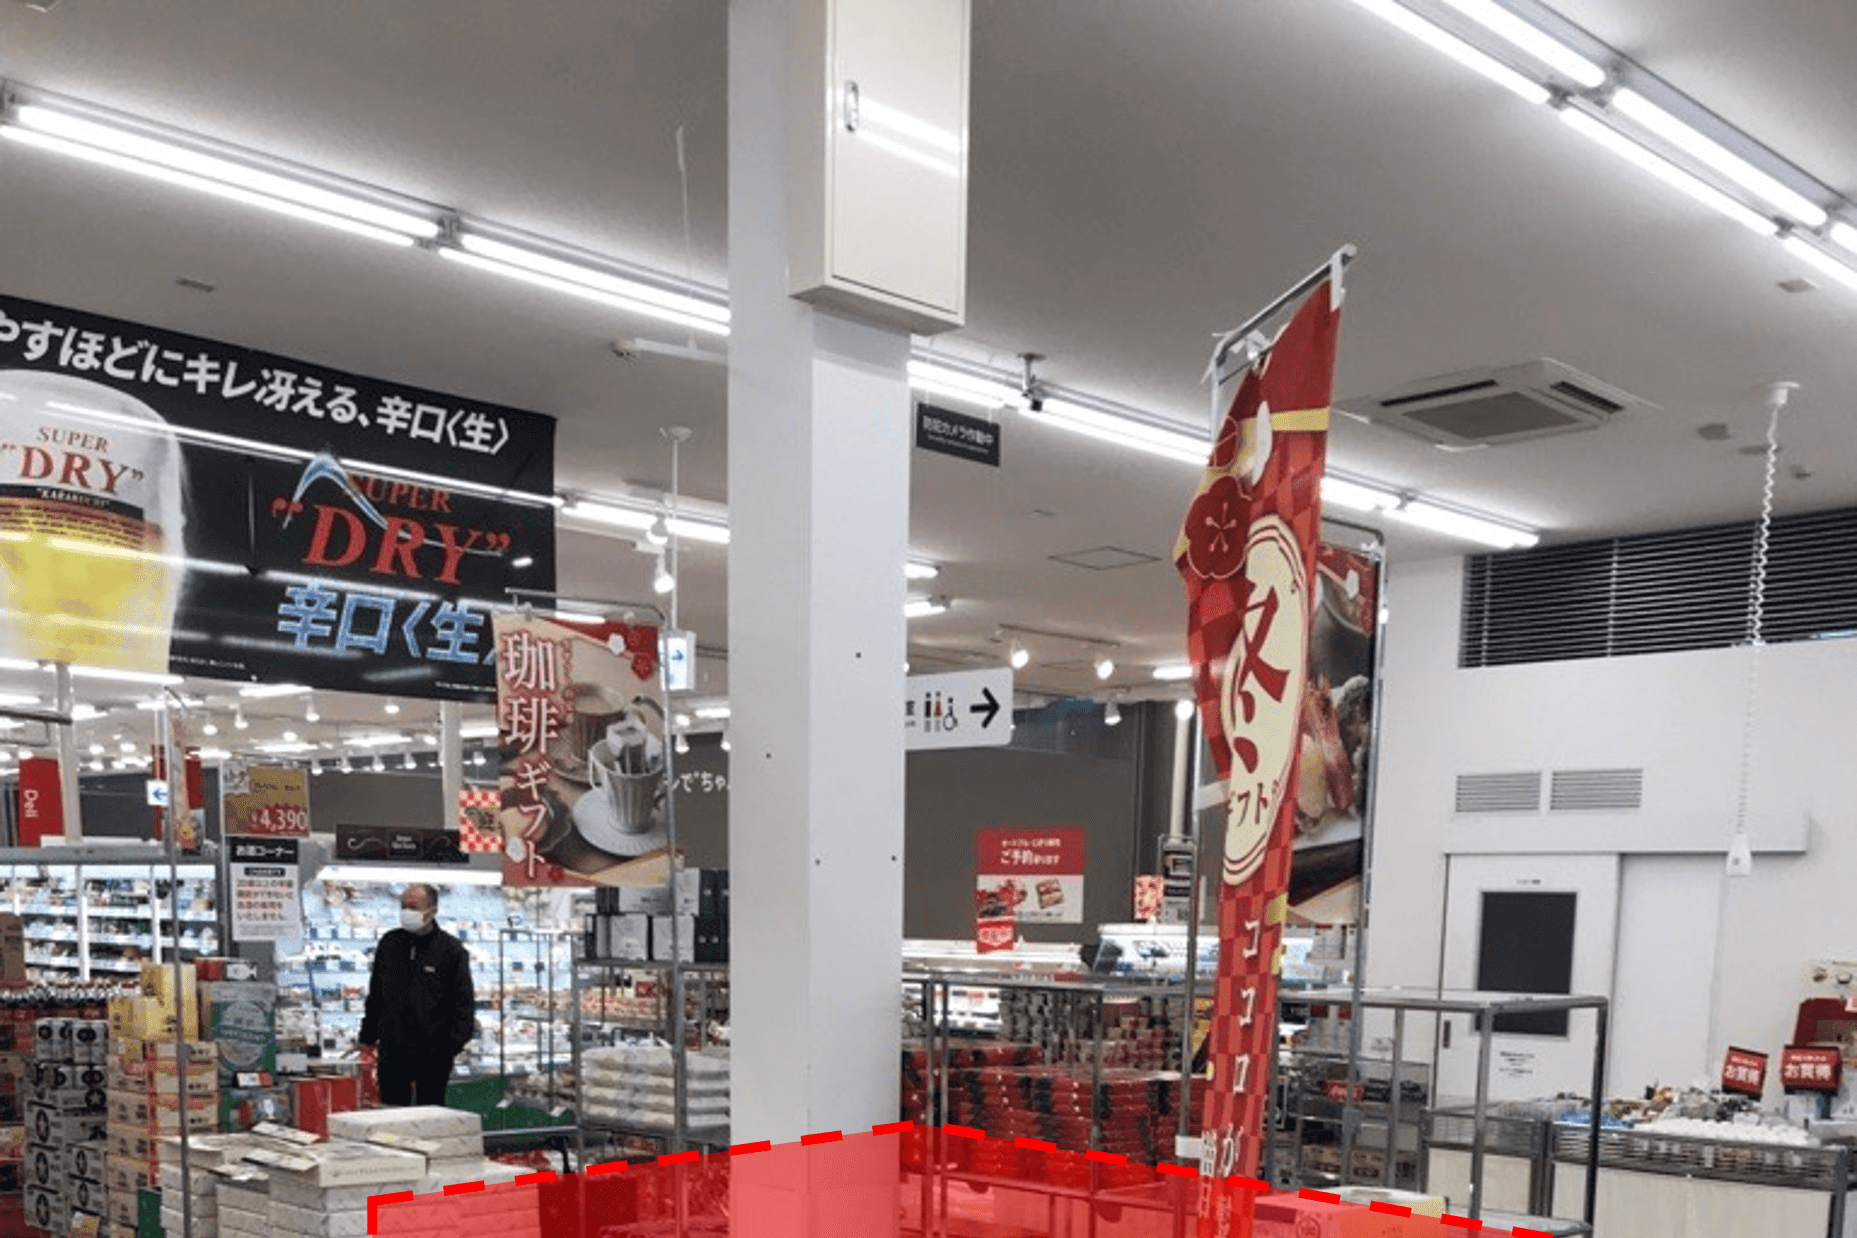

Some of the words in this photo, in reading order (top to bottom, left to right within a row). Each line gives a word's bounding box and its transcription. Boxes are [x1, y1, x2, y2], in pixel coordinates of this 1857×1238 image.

[36, 425, 109, 453] SUPER
[277, 582, 496, 665] 辛口〈生
